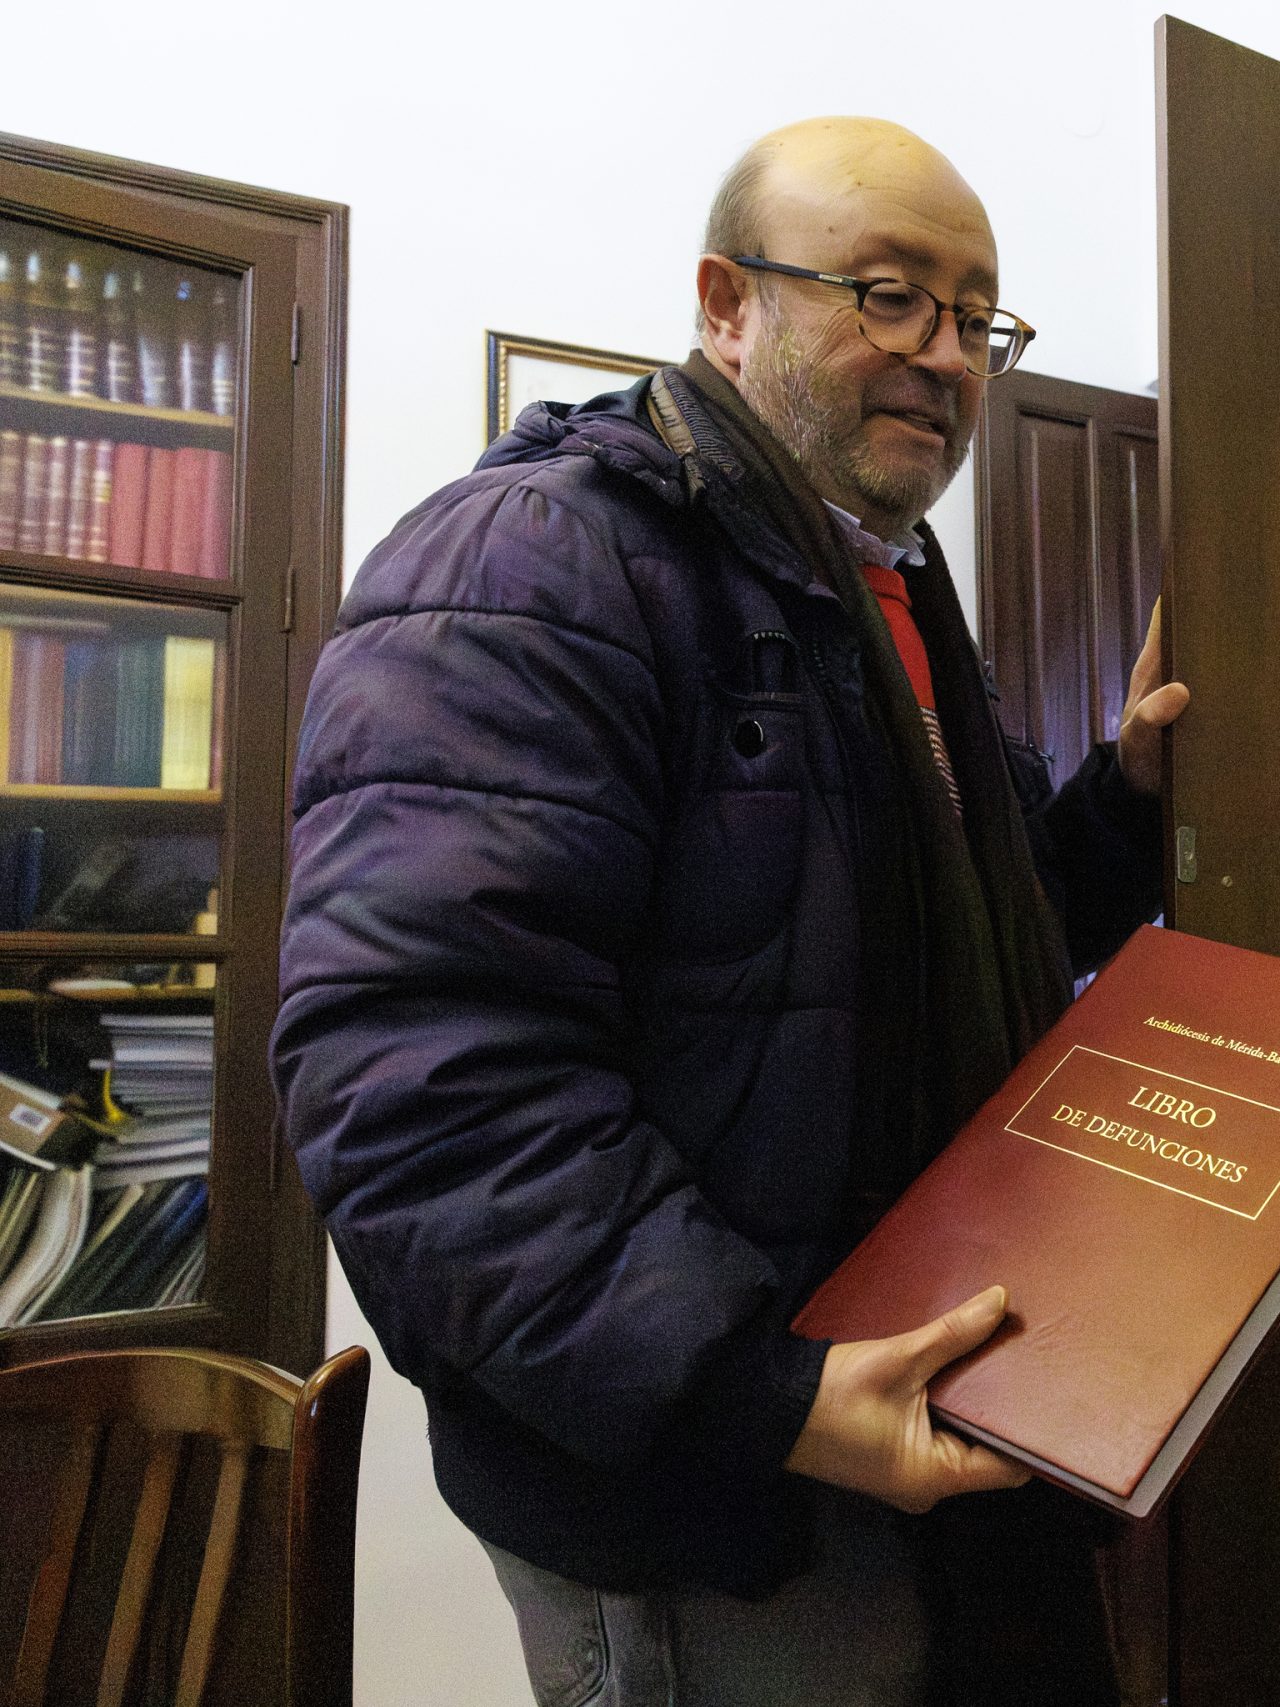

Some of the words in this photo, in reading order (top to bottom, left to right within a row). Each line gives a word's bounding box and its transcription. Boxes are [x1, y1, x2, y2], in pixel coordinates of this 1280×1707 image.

[1143, 1016, 1210, 1042] Archidiócesis
[1211, 1034, 1225, 1047] de
[1128, 1086, 1216, 1128] LIBRO
[1051, 1104, 1087, 1128] DE
[1084, 1115, 1248, 1183] DEFUNCIONES
